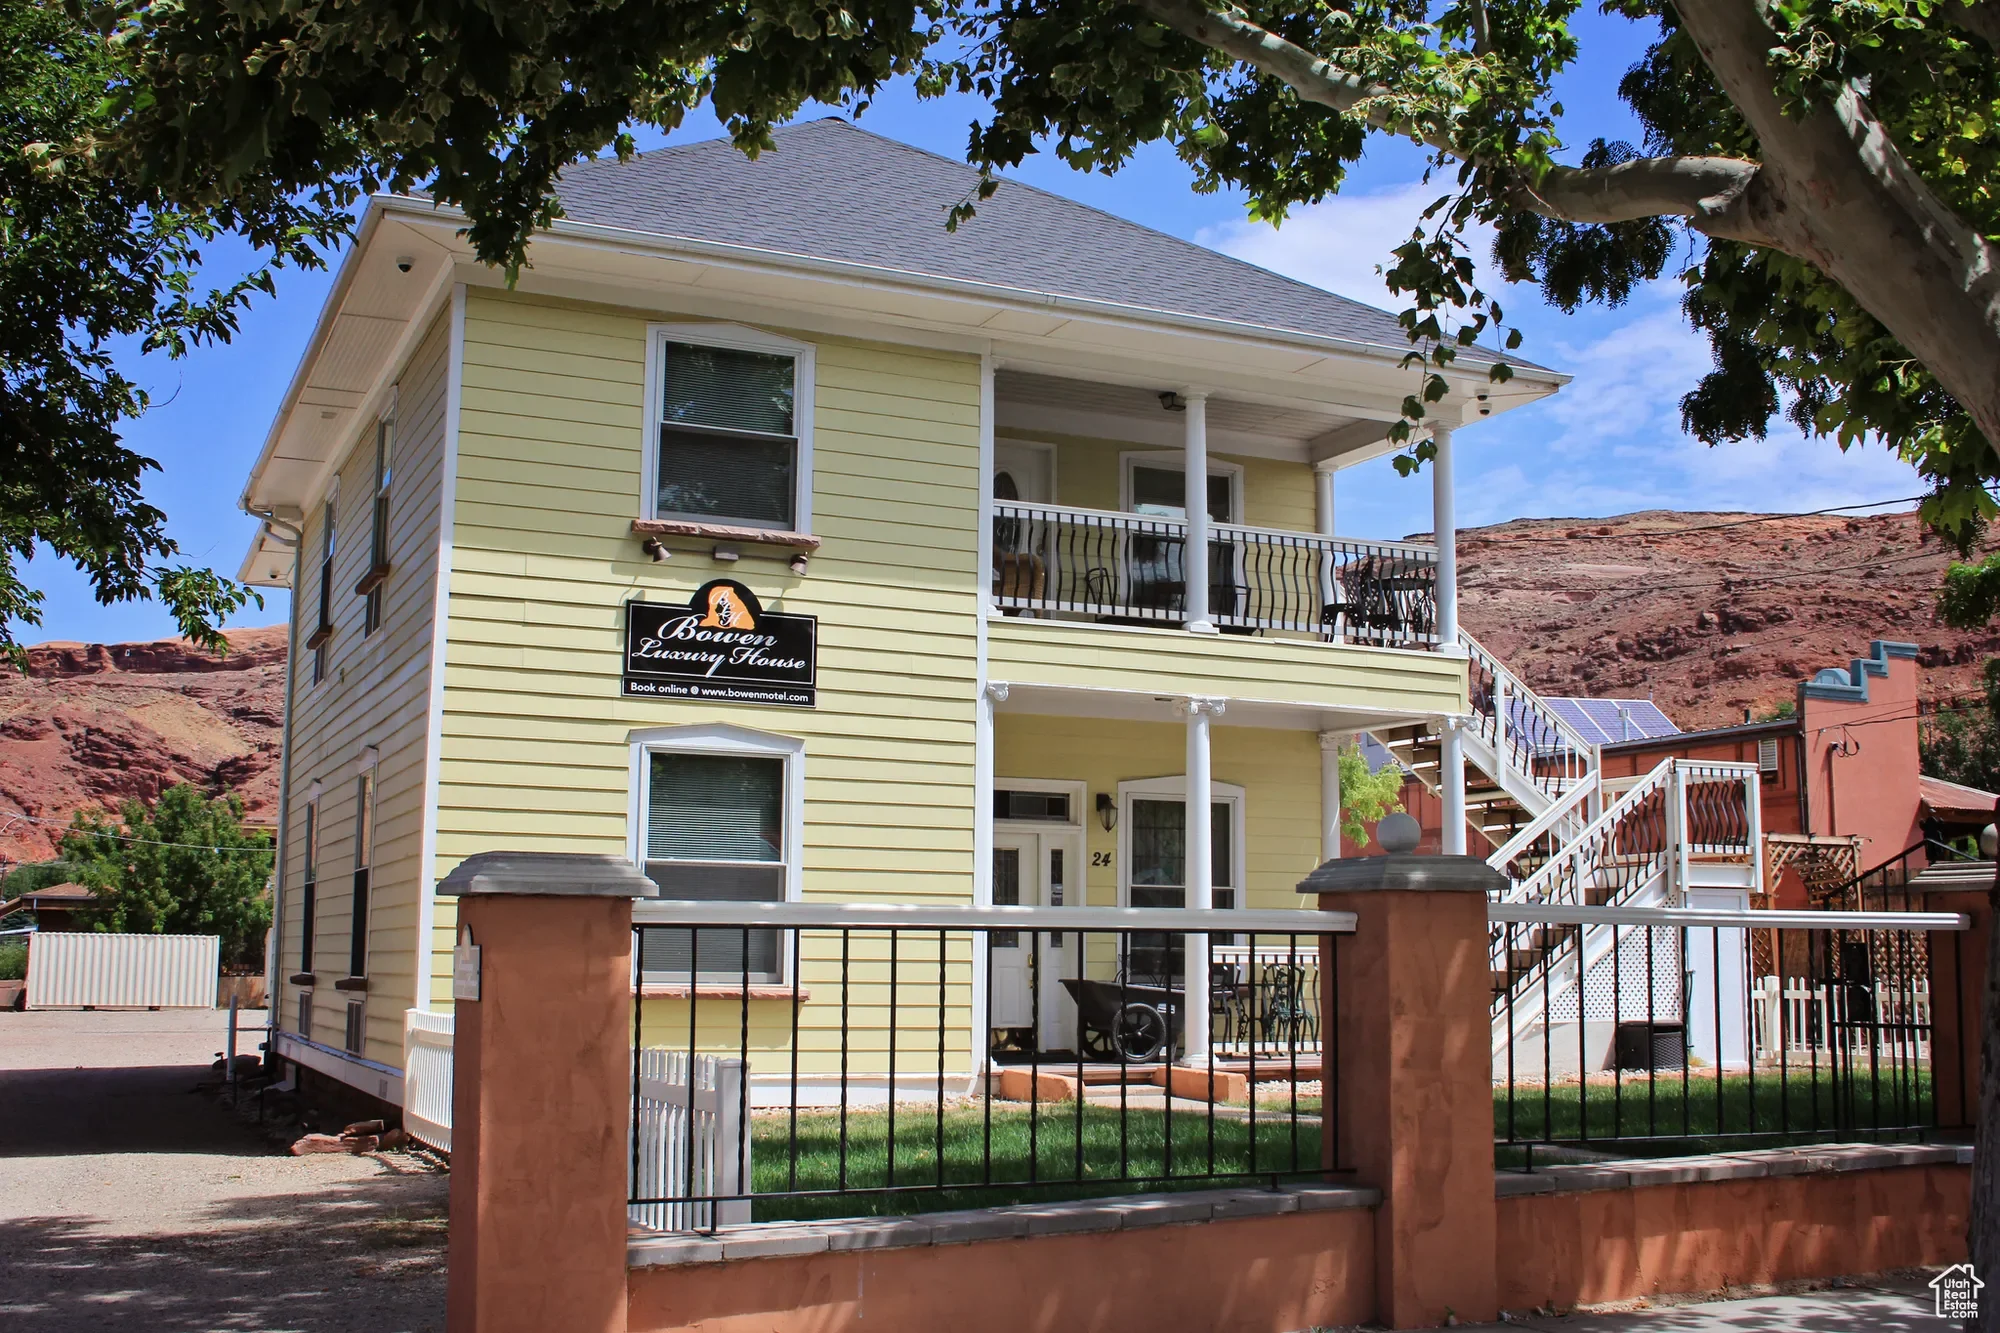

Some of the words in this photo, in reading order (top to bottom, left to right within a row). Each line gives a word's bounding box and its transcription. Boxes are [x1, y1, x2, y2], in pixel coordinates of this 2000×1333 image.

[657, 613, 777, 647] Bowen
[631, 637, 726, 678] Luxury
[728, 646, 806, 669] House
[630, 682, 656, 692] Book
[658, 685, 688, 695] online
[690, 686, 699, 695] @
[701, 688, 809, 702] www.bowenmotel.com
[1091, 851, 1112, 867] 24
